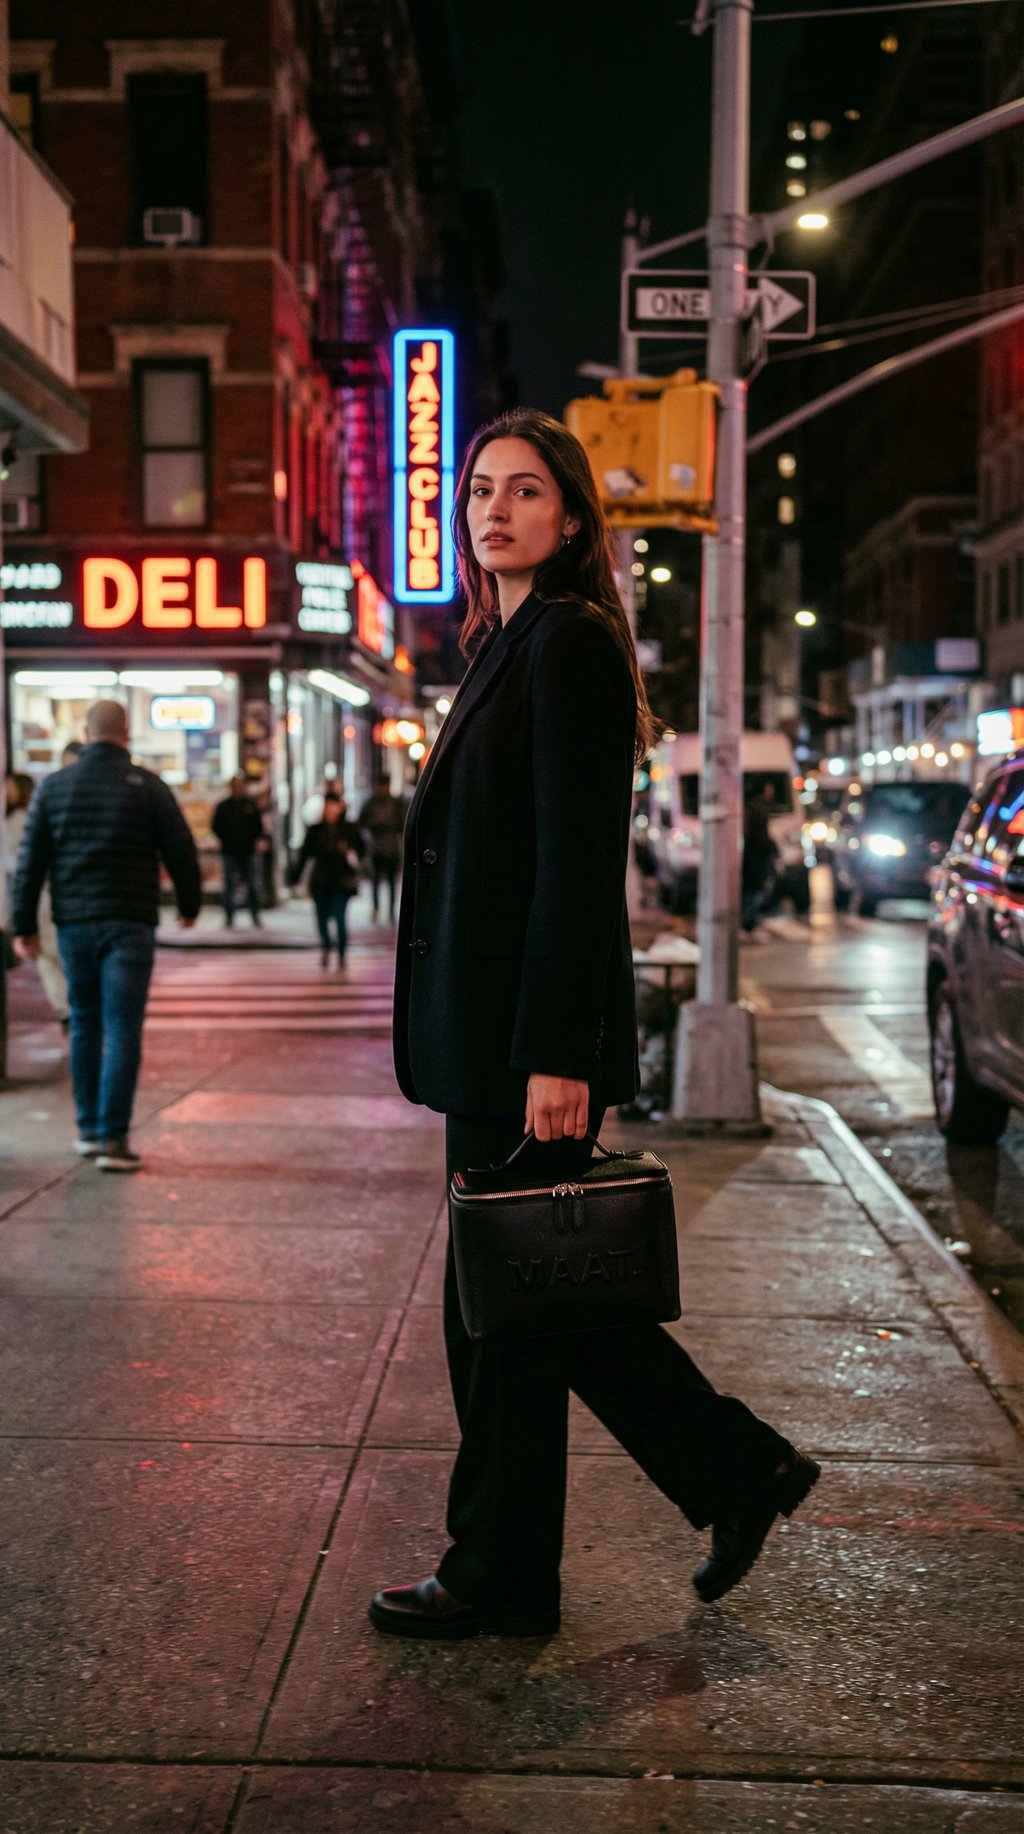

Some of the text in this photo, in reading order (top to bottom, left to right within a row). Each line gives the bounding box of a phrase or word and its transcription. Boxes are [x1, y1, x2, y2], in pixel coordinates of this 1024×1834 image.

[652, 293, 705, 316] ONE
[407, 341, 440, 590] JAZZ CLUB
[83, 557, 267, 629] DELI
